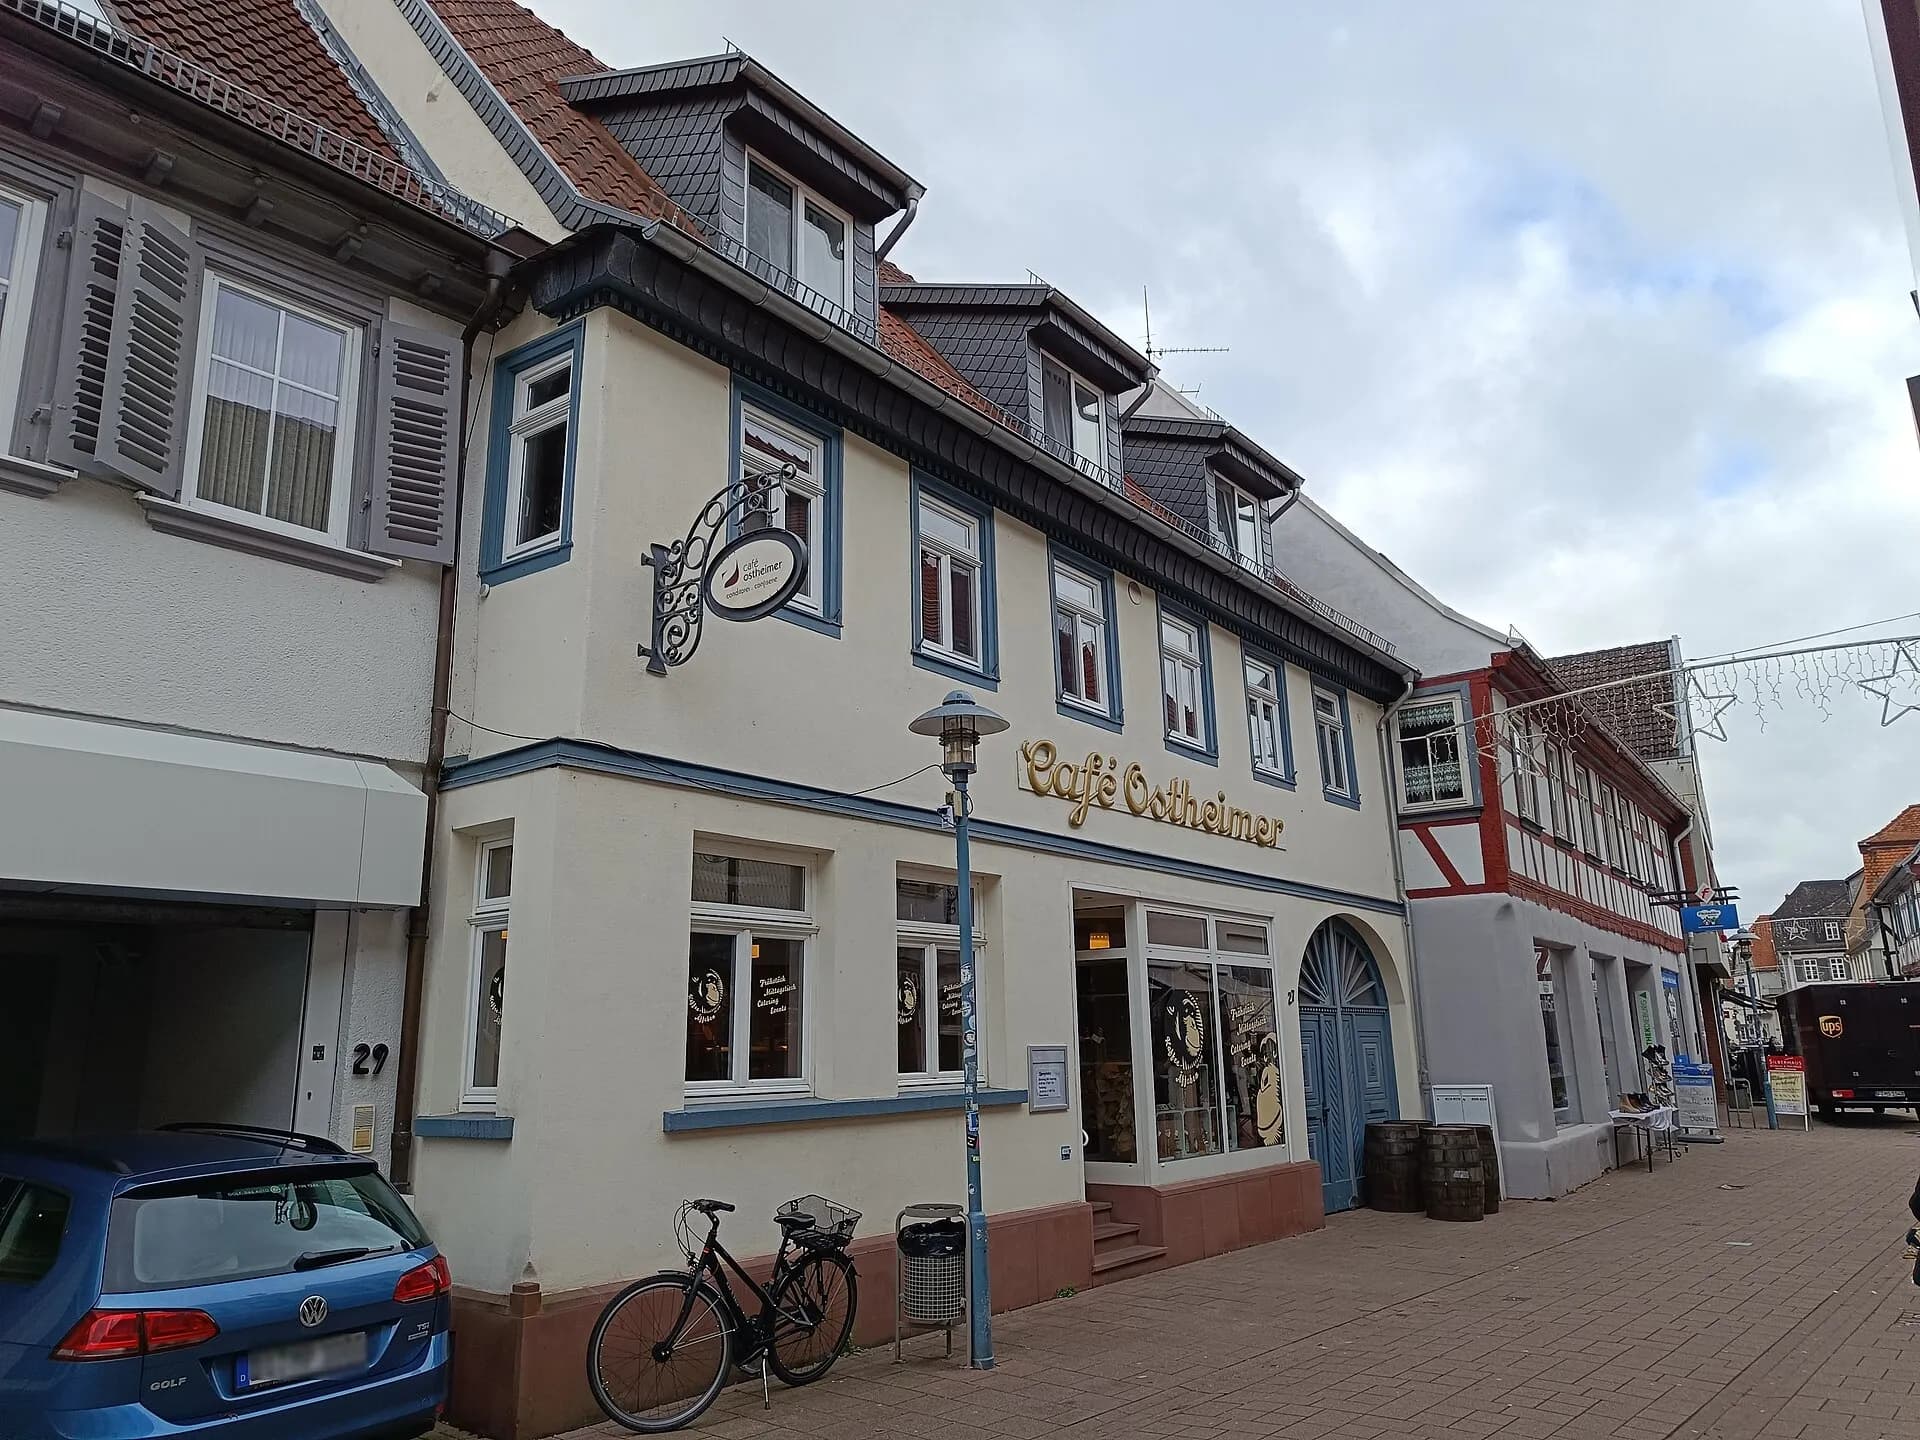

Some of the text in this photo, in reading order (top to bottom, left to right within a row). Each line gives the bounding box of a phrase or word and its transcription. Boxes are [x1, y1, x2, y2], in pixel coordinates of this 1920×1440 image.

[743, 558, 759, 571] café
[743, 561, 783, 581] ostheimer
[1022, 739, 1284, 848] Café Ostheimer
[760, 976, 786, 988] Frühstück
[757, 998, 779, 1008] Catering
[1287, 989, 1295, 1006] 27
[770, 1005, 787, 1015] Events
[1822, 1021, 1841, 1035] ups
[1230, 1040, 1251, 1055] Catering
[352, 1043, 390, 1075] 29
[1240, 1053, 1257, 1067] Events
[150, 1377, 188, 1391] GOLF
[240, 1374, 246, 1383] D
